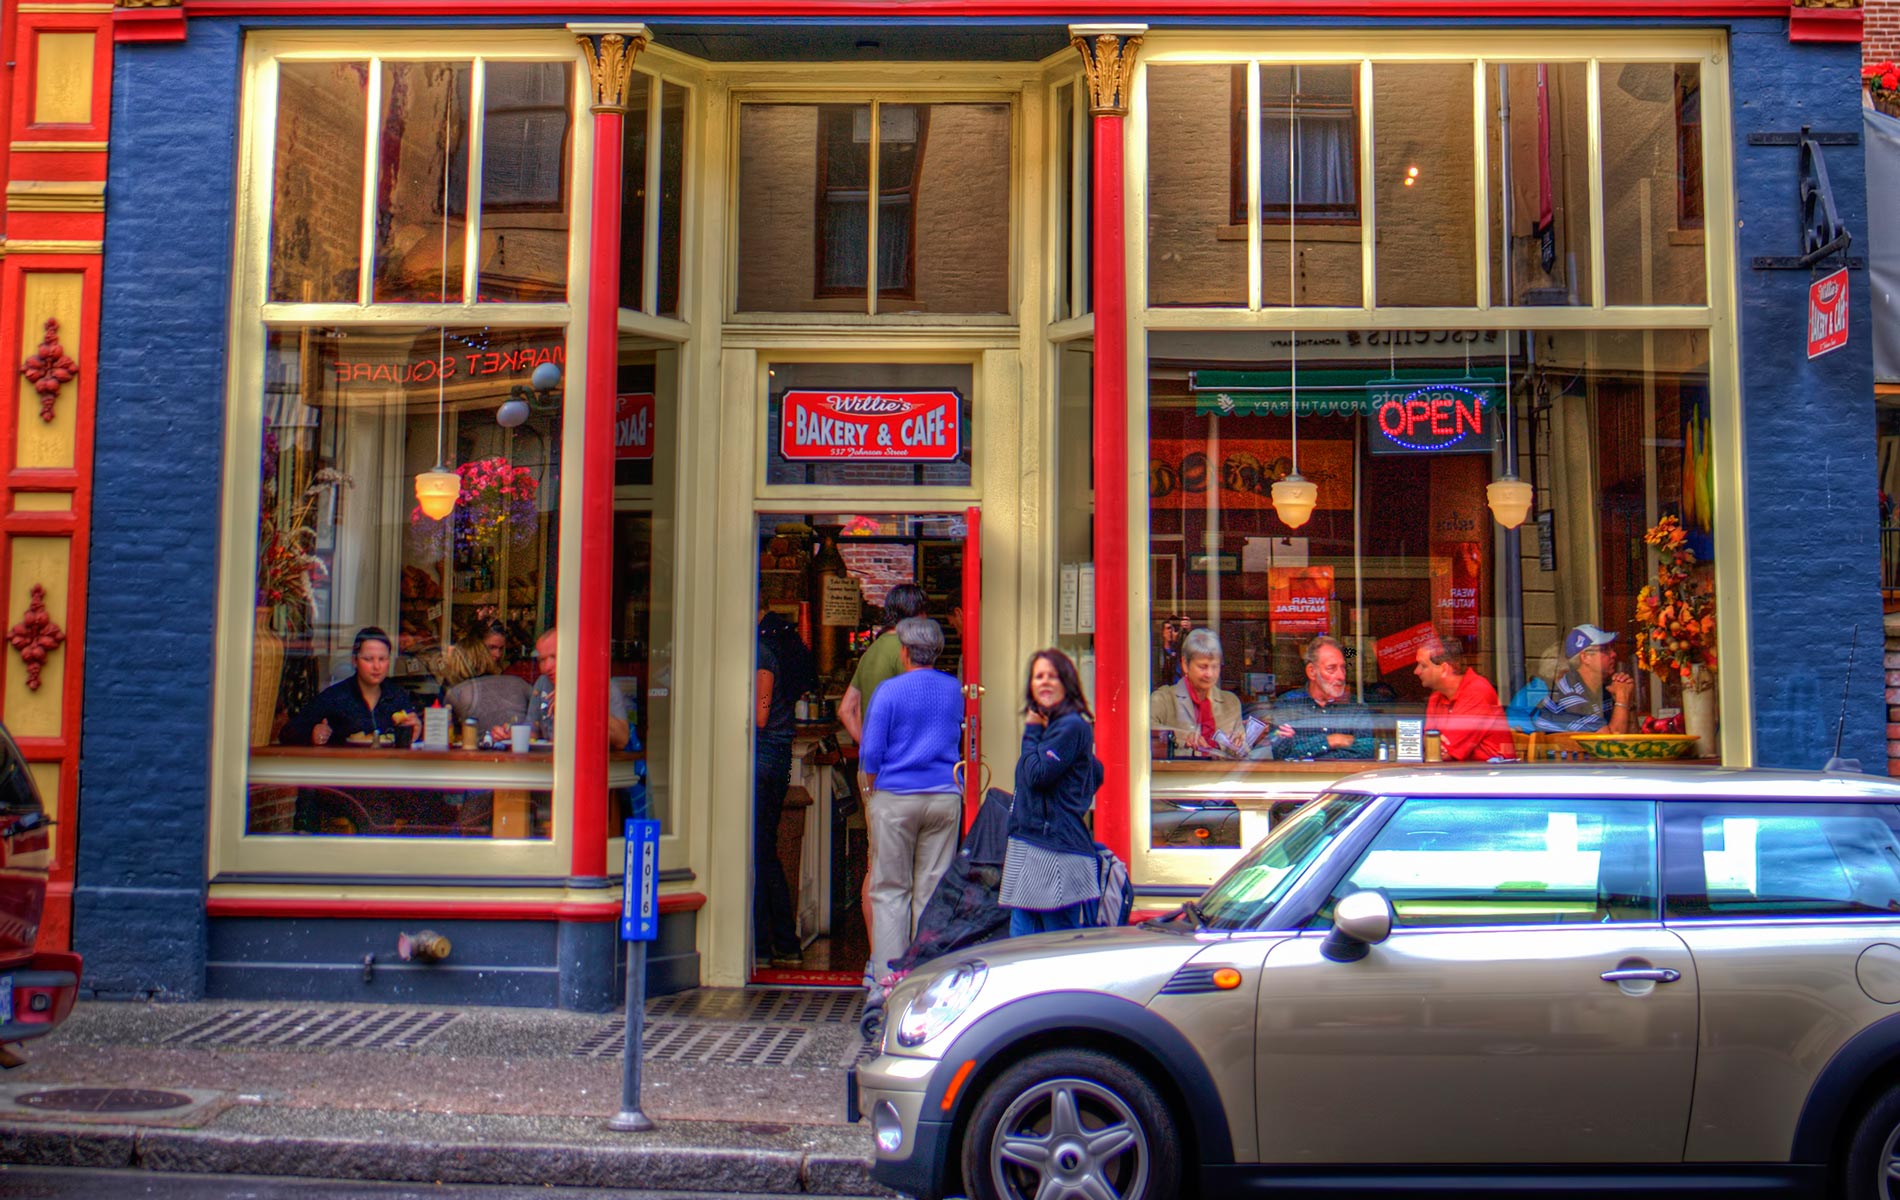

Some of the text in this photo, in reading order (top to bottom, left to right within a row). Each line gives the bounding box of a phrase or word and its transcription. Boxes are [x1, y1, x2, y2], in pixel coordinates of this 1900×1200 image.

[826, 394, 912, 412] Willie's
[1379, 397, 1482, 436] OPEN
[796, 404, 946, 446] BAKERY & CAFE
[645, 825, 653, 839] P
[643, 844, 652, 914] 4016
